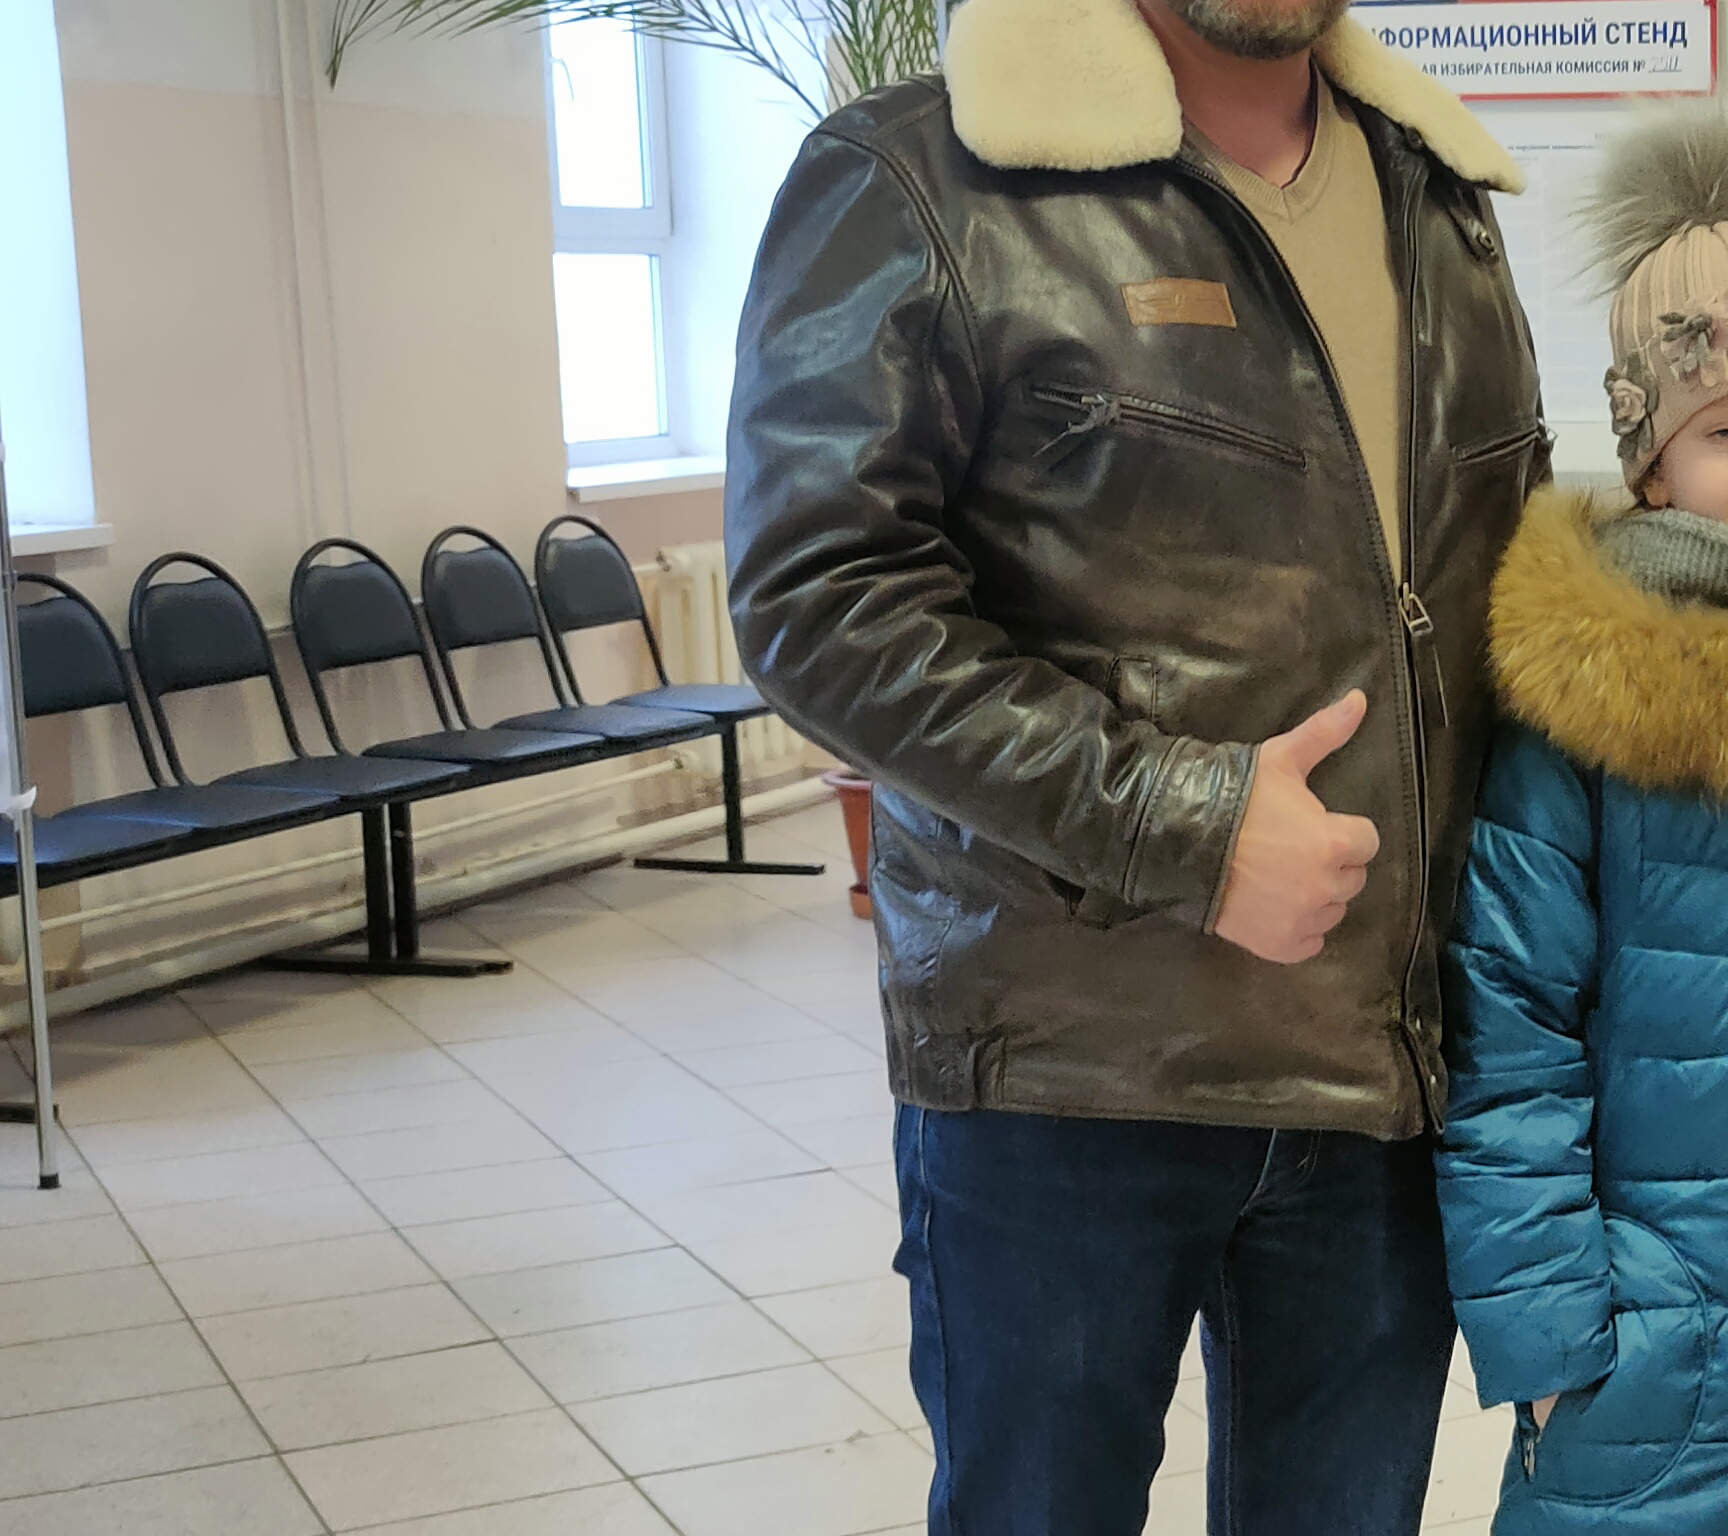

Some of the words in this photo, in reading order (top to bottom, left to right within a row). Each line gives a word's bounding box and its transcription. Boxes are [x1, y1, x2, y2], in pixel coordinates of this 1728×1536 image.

[1371, 15, 1597, 51] ФОРМАЦИОННЫЙ
[1605, 20, 1688, 49] СТЕНД
[1440, 59, 1552, 76] ИЗБИРАТЕЛЬНАЯ
[1555, 58, 1629, 75] КОМИССИЯ
[1633, 58, 1646, 73] №
